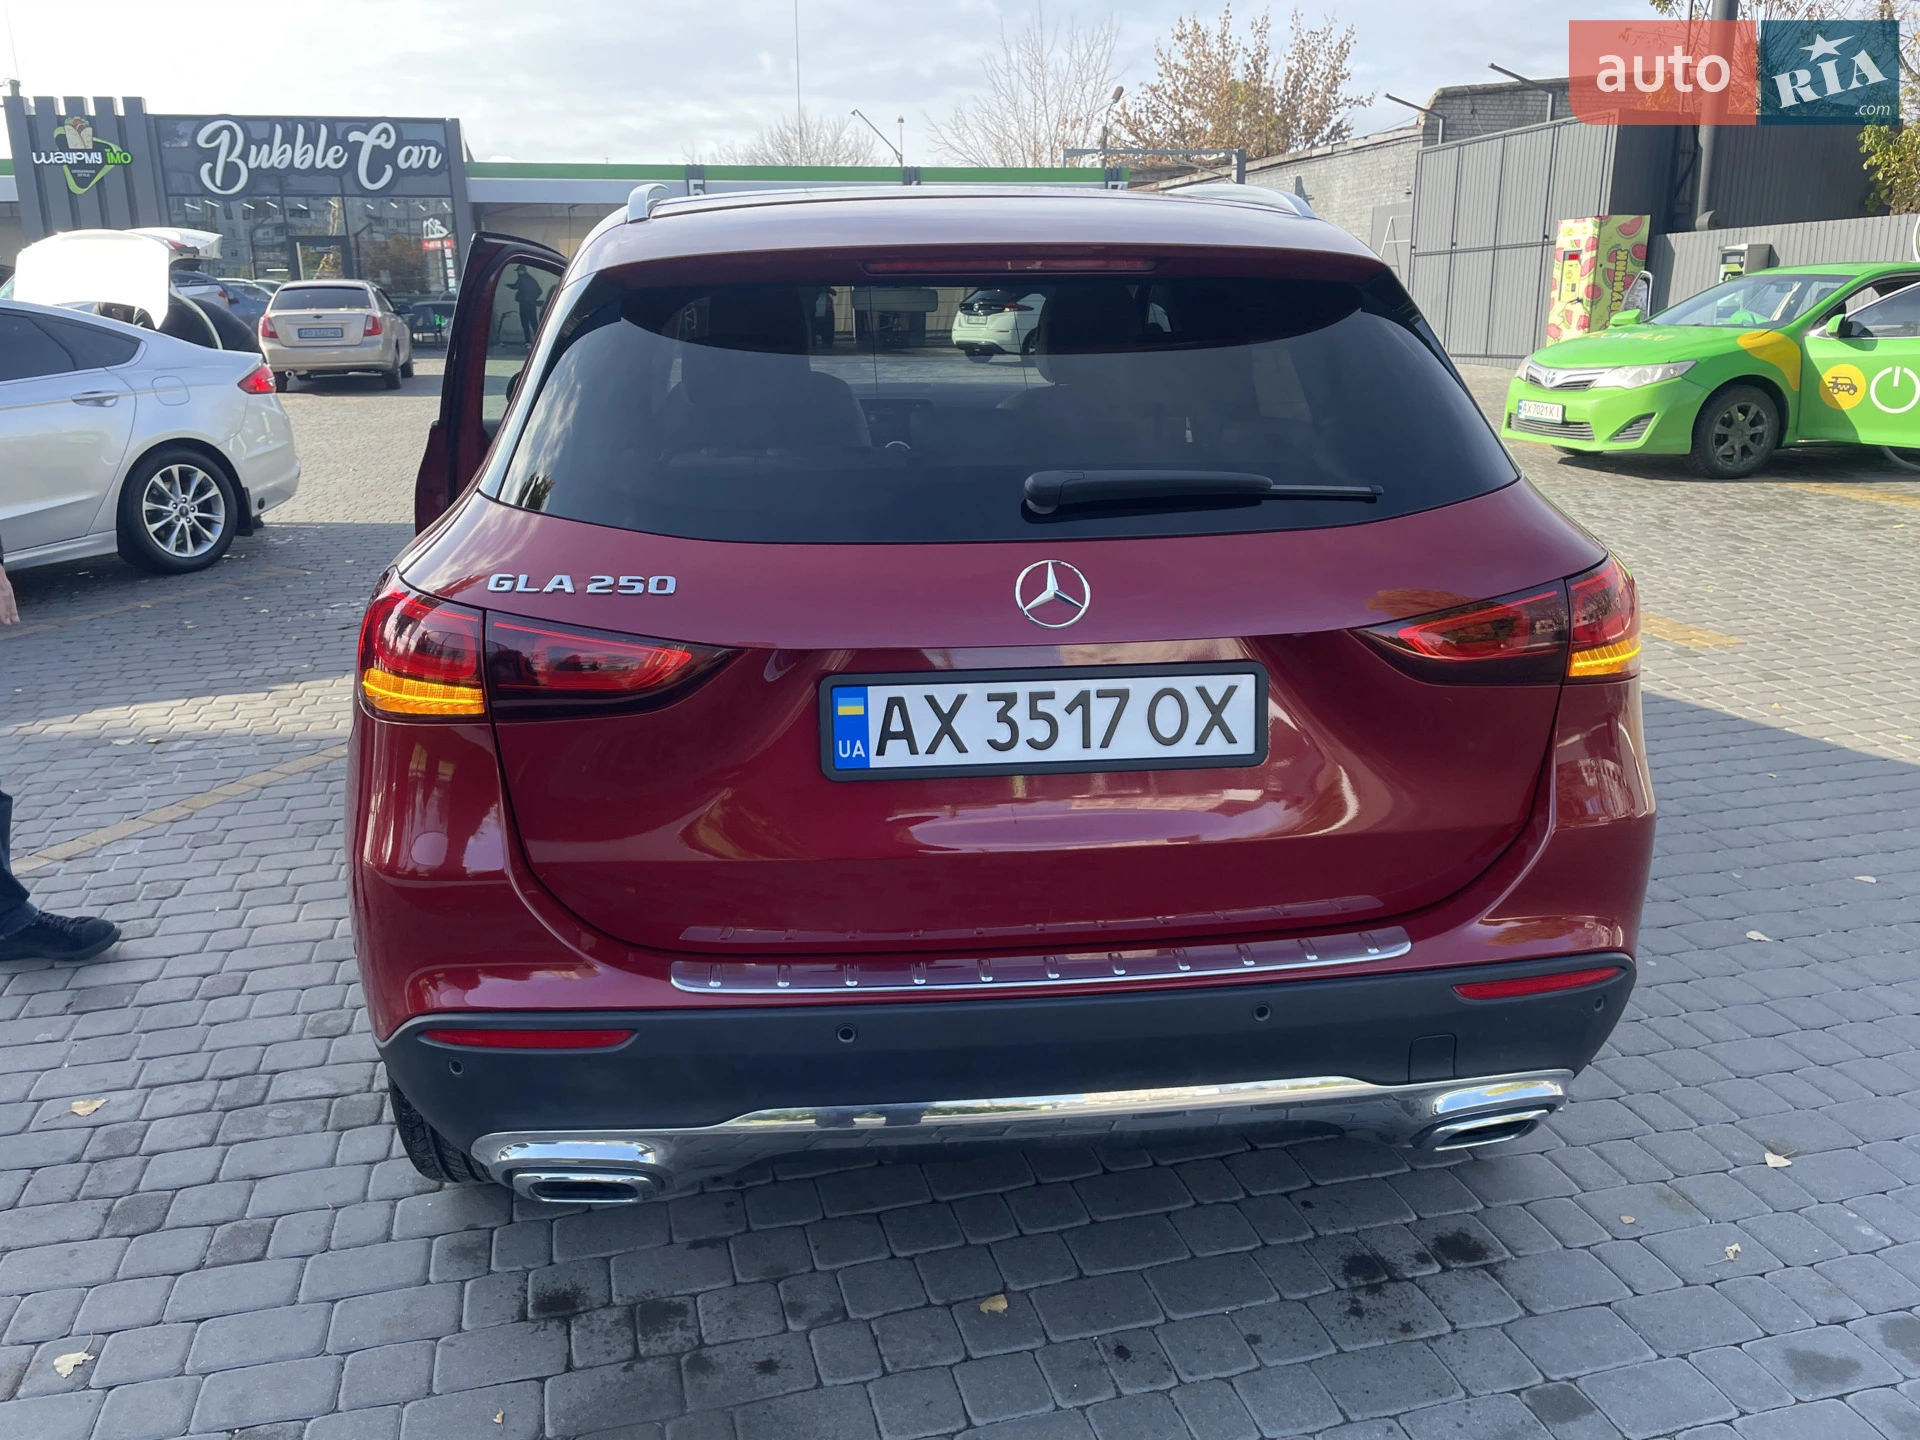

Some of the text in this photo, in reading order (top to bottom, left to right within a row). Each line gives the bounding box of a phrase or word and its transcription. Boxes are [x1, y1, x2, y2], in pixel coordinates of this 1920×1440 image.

[196, 119, 443, 196] Bubble Car
[487, 574, 678, 595] GLA 250
[875, 684, 1239, 757] AX 3517 OX
[838, 739, 866, 758] UA
